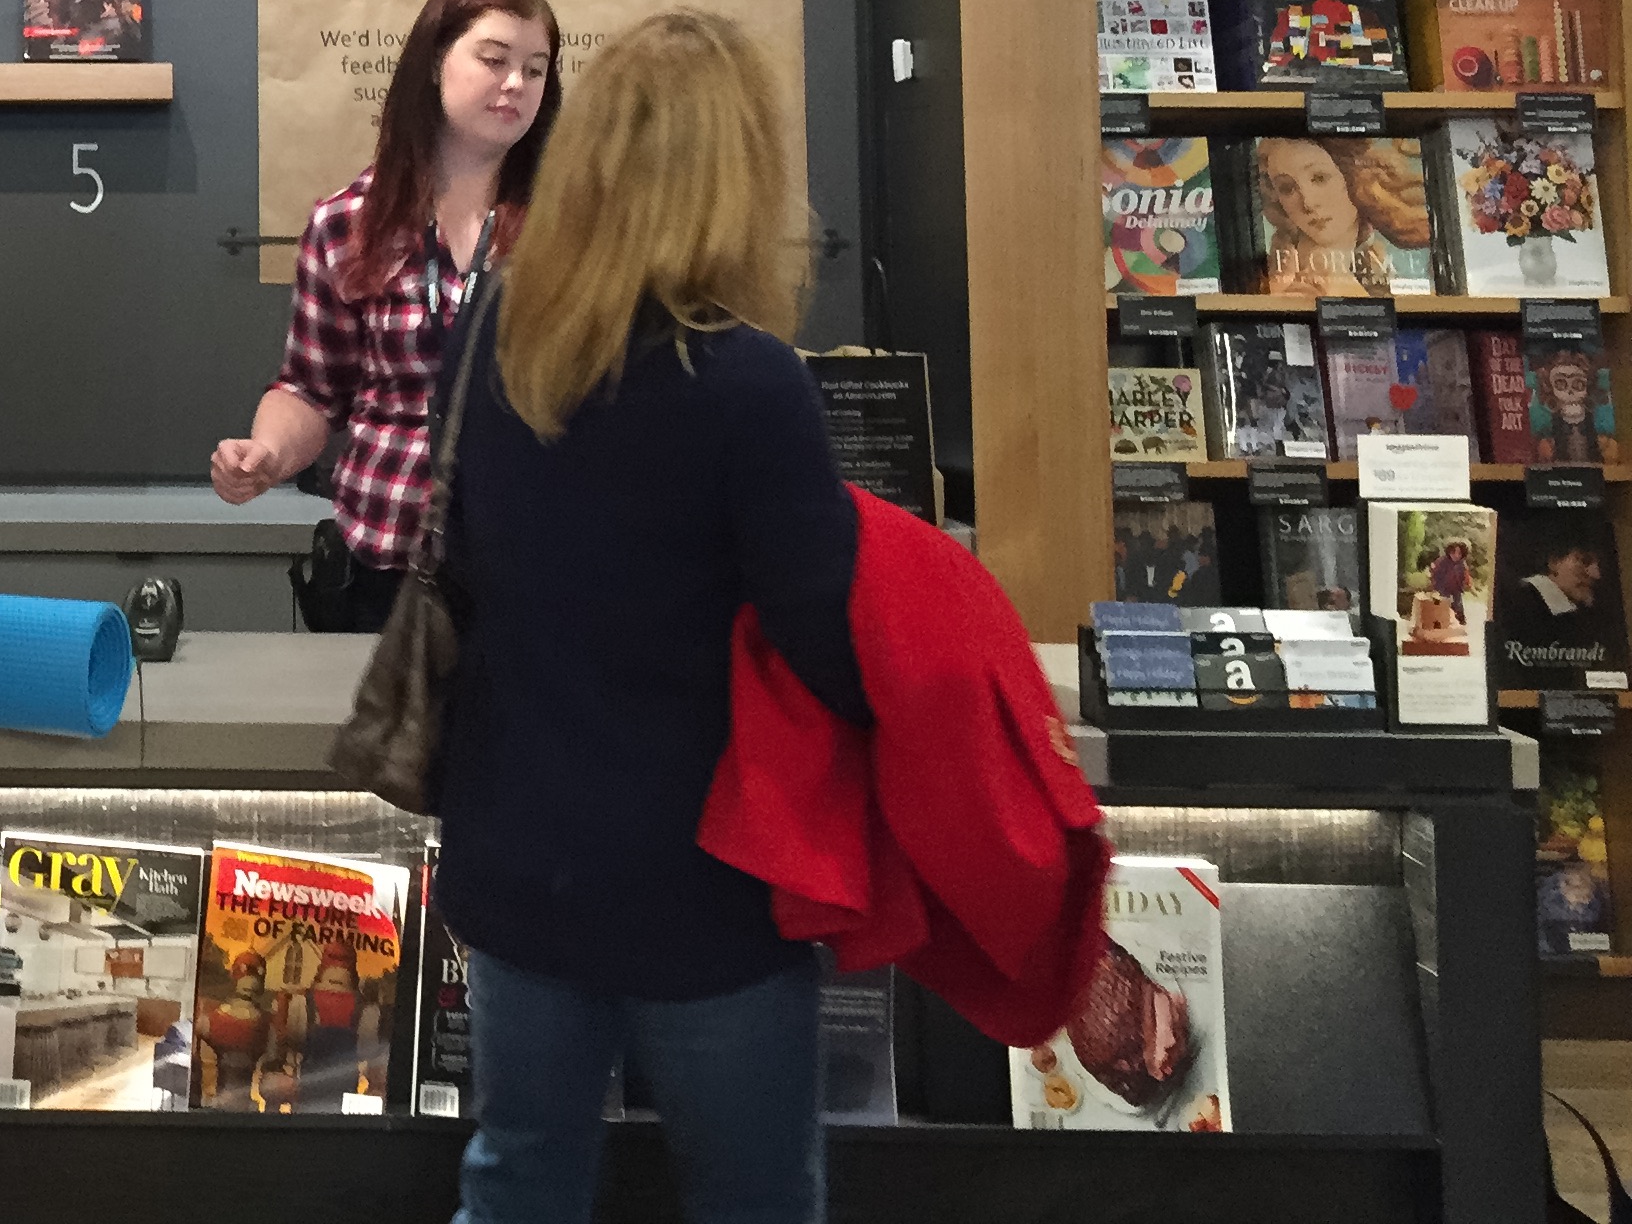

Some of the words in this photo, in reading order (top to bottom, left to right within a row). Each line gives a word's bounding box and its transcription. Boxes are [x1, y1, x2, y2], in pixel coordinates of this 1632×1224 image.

[319, 29, 371, 49] We'd
[375, 29, 409, 49] lov
[340, 54, 399, 75] feedb
[69, 143, 104, 214] 5
[1274, 247, 1426, 275] FLORENCE
[1491, 373, 1526, 394] DEAD
[1109, 390, 1190, 409] ARLEY
[1501, 412, 1523, 431] ART
[1278, 513, 1355, 536] SARG
[1210, 612, 1237, 632] a
[1218, 636, 1246, 656] a
[1505, 639, 1607, 666] Rembrandt
[1225, 658, 1257, 691] a
[8, 846, 139, 915] Gray
[234, 869, 383, 920] Newsweek
[1110, 890, 1185, 917] IDAY
[216, 891, 265, 915] THE
[267, 898, 359, 930] FUTURE
[252, 917, 286, 940] OF
[289, 922, 397, 959] FARMING
[1158, 949, 1208, 964] Festive
[1154, 961, 1208, 977] Recipes
